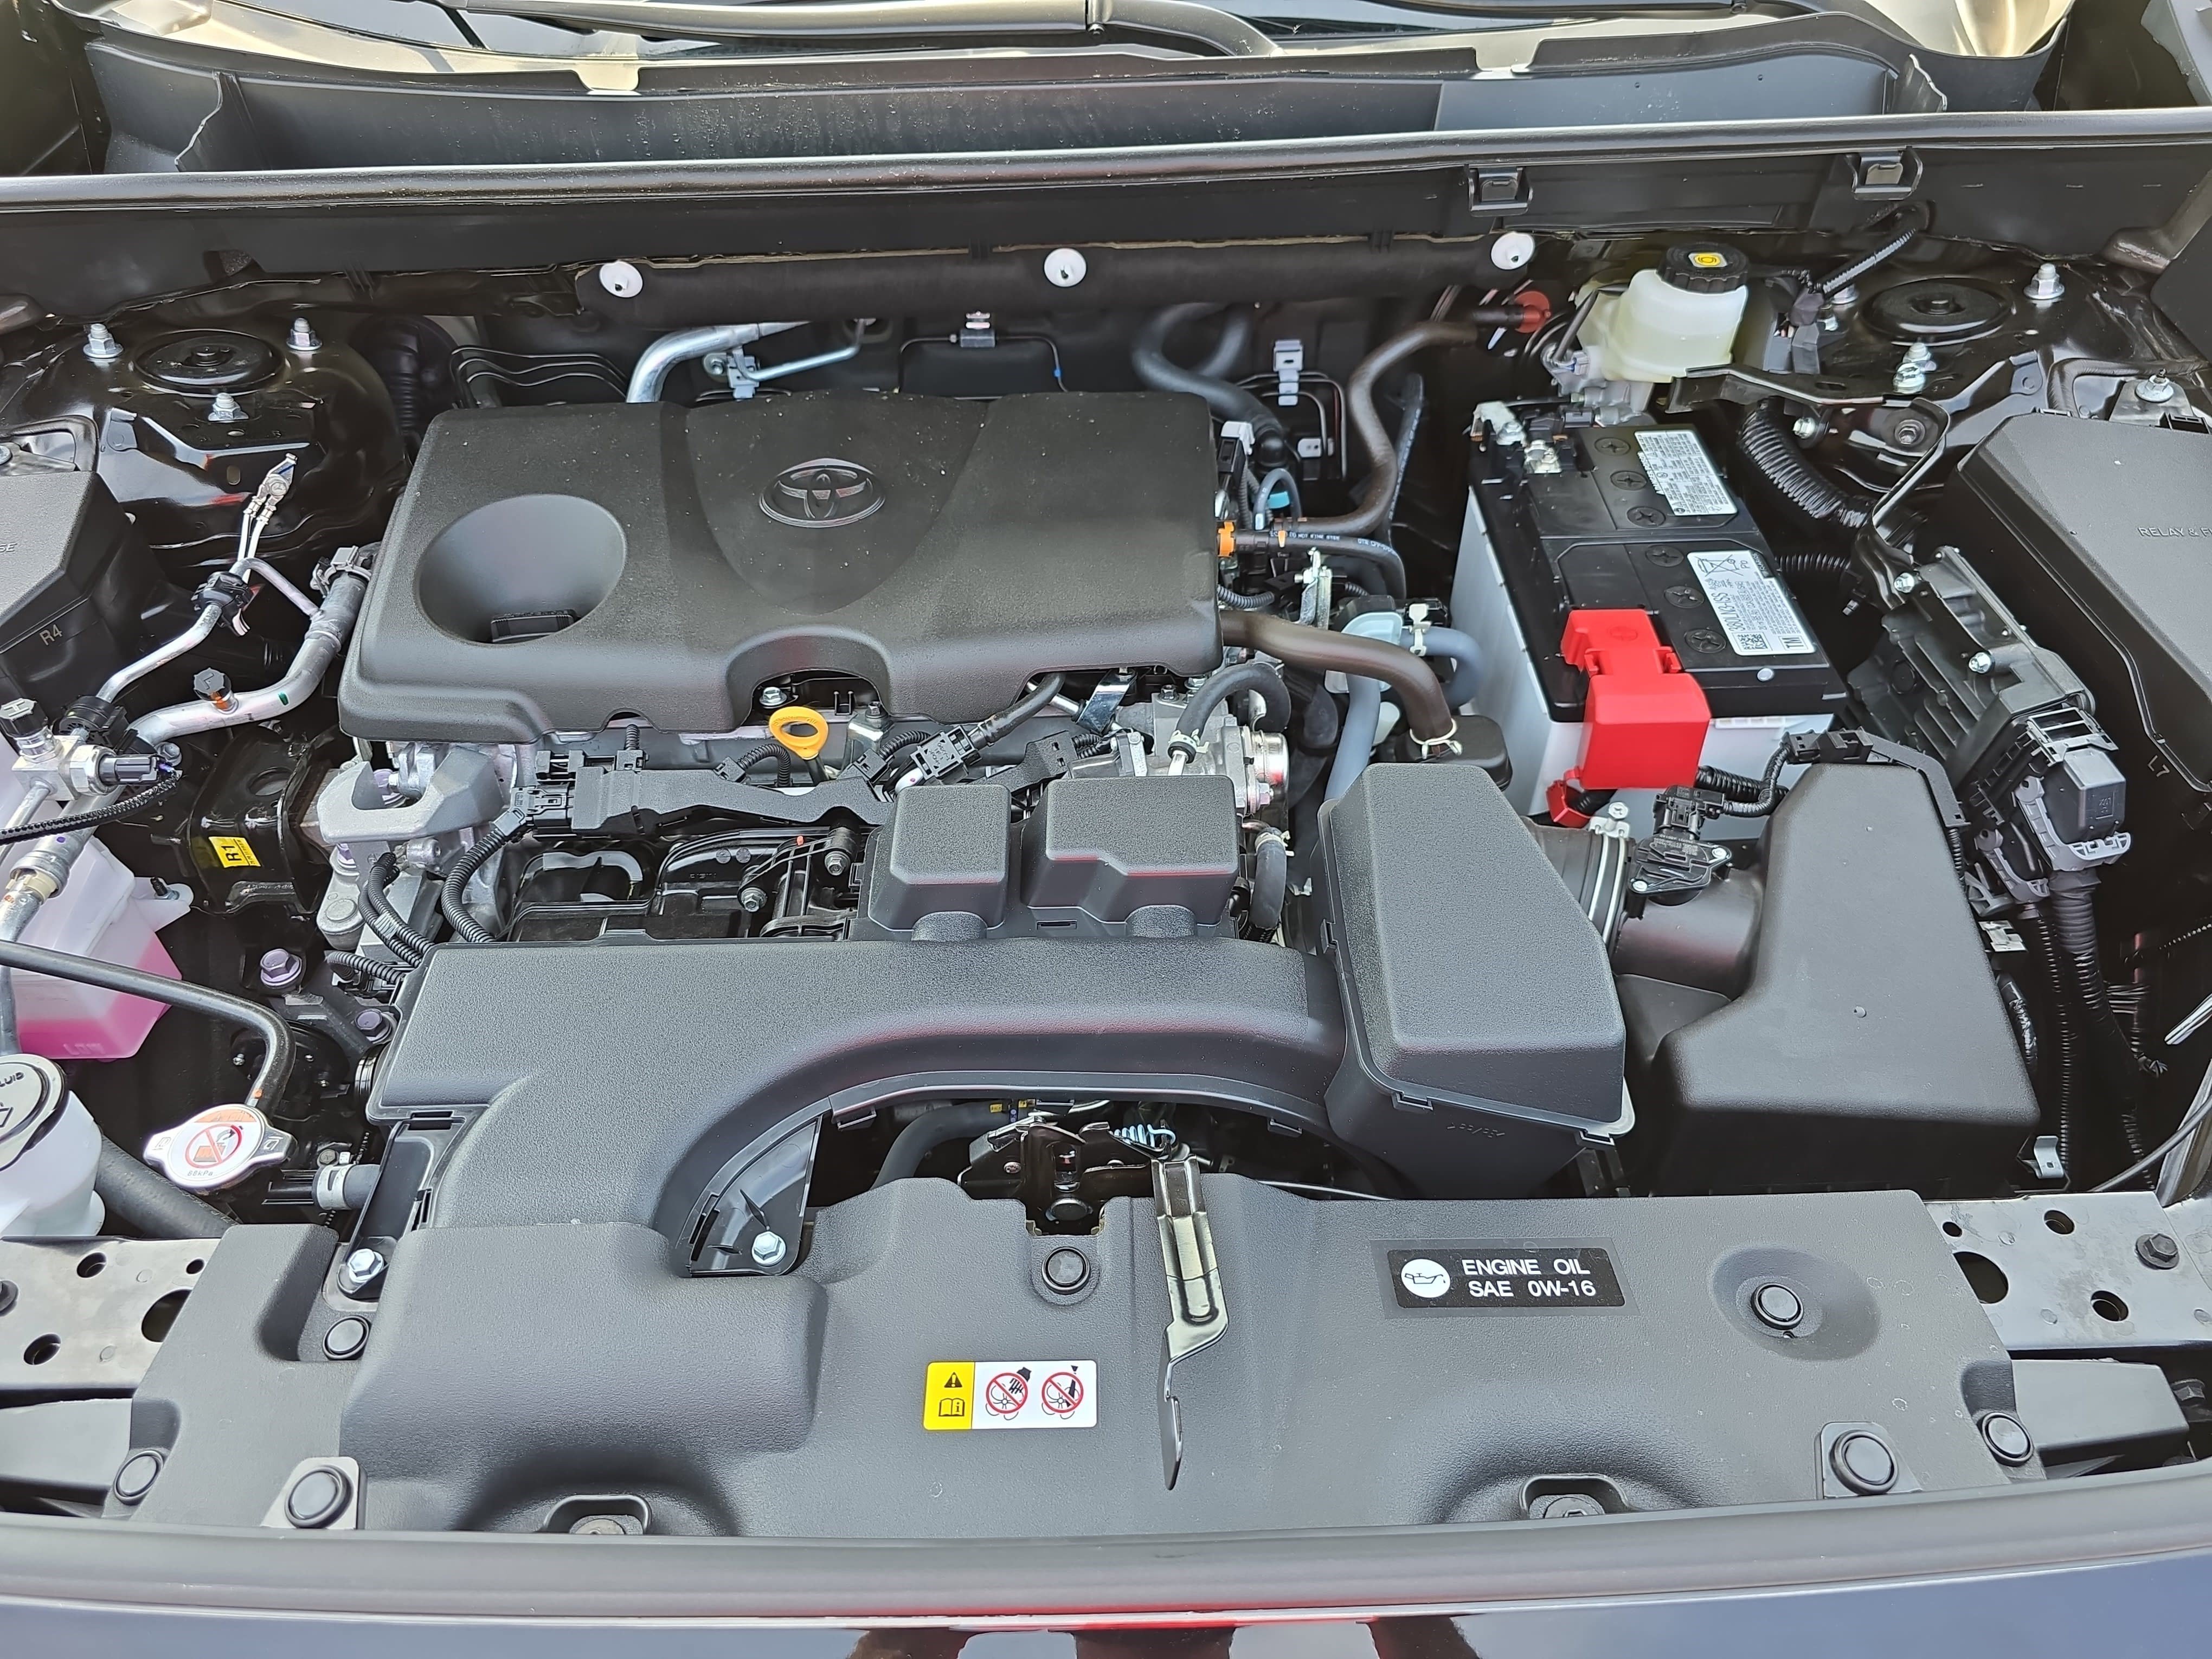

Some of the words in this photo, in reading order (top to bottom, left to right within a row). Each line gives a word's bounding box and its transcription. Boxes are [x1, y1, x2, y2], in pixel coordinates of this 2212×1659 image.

[2137, 527, 2184, 537] RELAY
[2188, 528, 2200, 537] &
[40, 624, 62, 646] R4
[1782, 637, 1804, 648] TM
[2147, 755, 2170, 777] L7
[221, 845, 242, 861] R1
[1462, 1259, 1541, 1275] ENGINE
[1554, 1259, 1590, 1275] OIL
[1469, 1280, 1514, 1297] SAE
[1528, 1279, 1596, 1297] 0W-16
